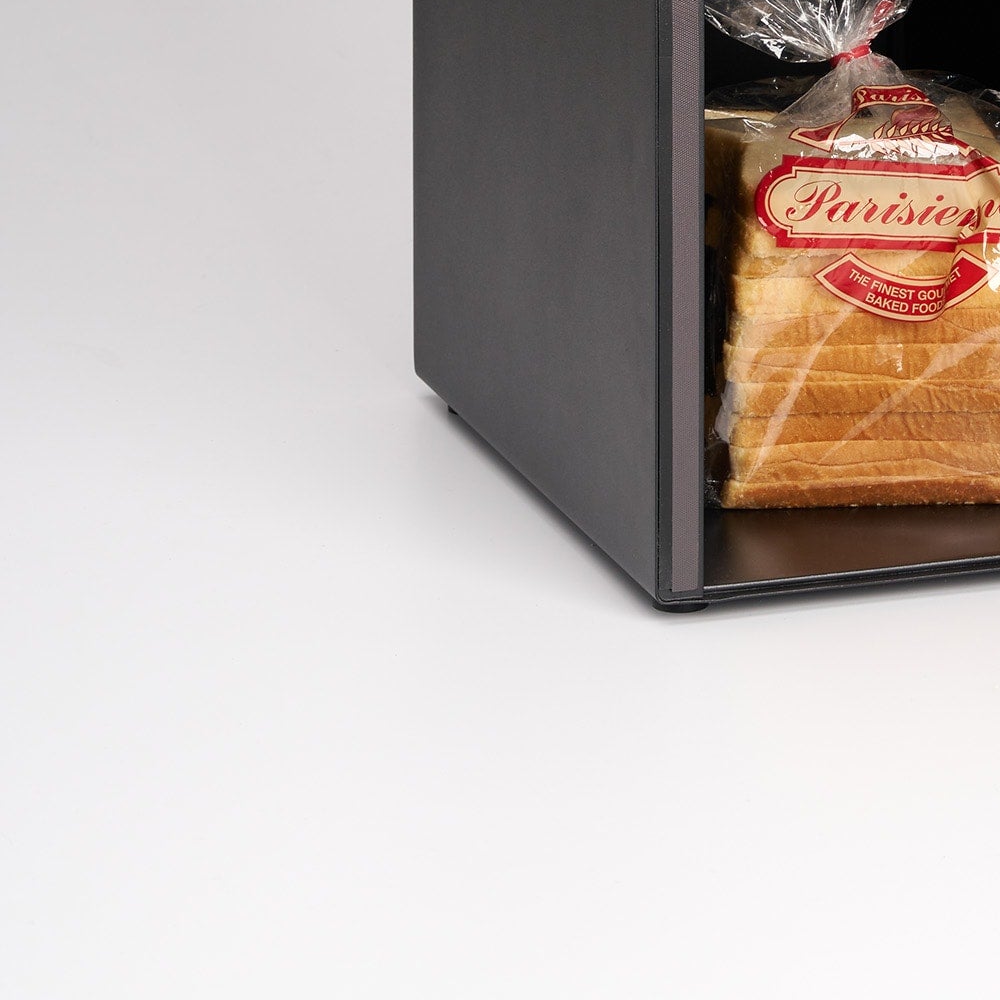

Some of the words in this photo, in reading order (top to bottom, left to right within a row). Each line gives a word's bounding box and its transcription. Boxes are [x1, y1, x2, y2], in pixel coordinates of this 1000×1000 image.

[848, 268, 872, 287] THE
[870, 279, 916, 301] FINEST
[865, 292, 909, 313] BAKED
